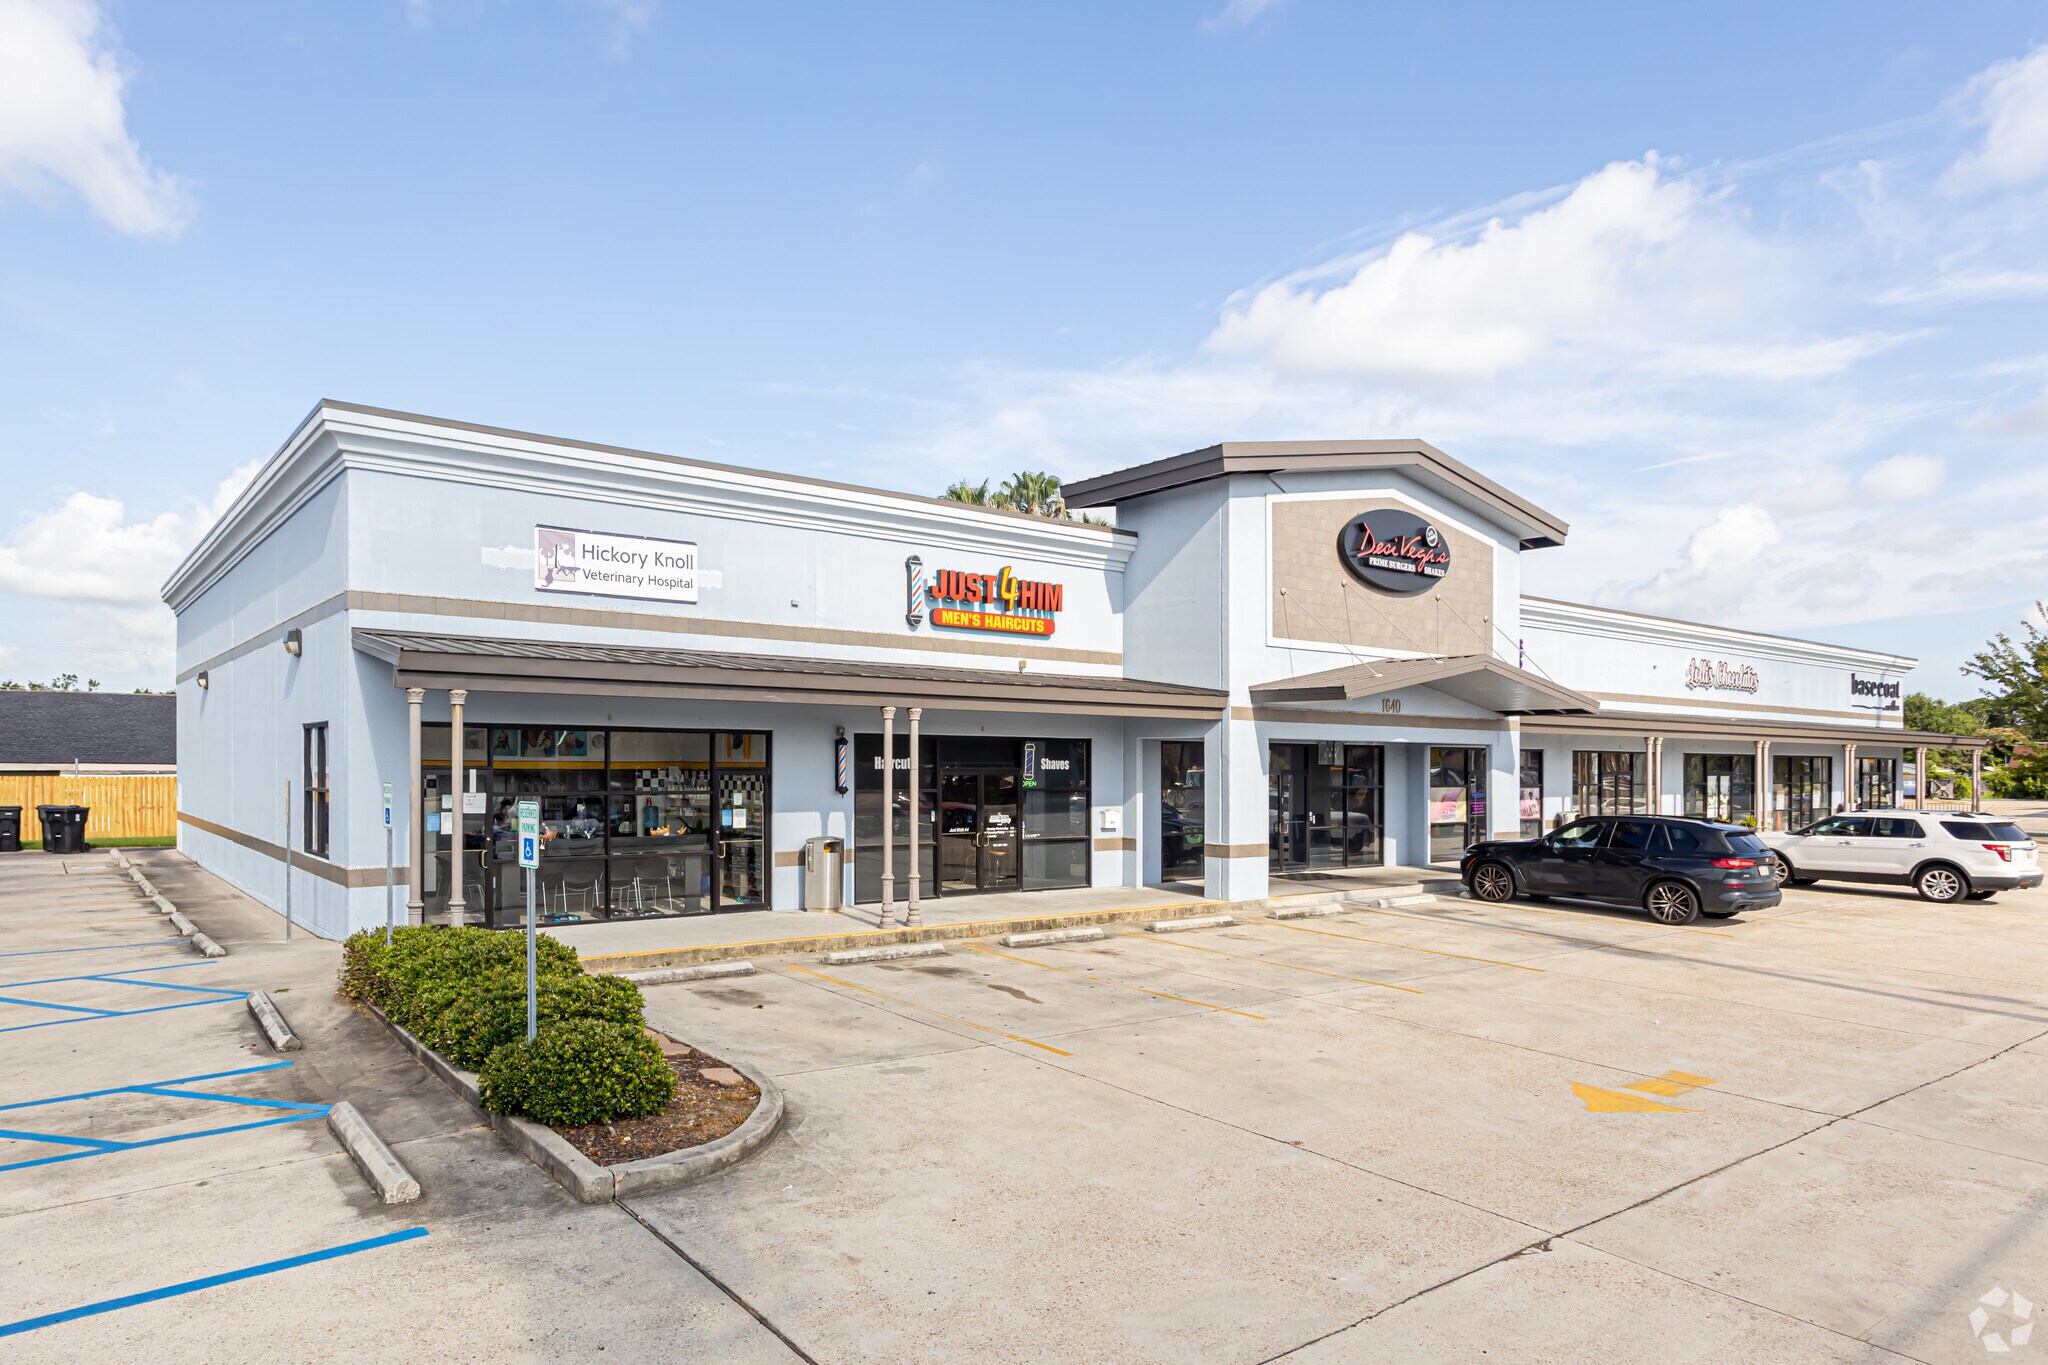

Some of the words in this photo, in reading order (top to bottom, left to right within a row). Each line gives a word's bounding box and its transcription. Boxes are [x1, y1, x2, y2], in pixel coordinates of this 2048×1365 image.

[582, 543, 648, 569] Hickory
[654, 551, 694, 570] Knoll
[1357, 521, 1399, 558] Desi
[1399, 534, 1451, 573] Vega's
[1368, 556, 1389, 568] PRIME
[1388, 561, 1416, 572] BURGERS
[1423, 566, 1445, 577] SHAKES
[582, 568, 644, 587] Veterinary
[648, 575, 694, 590] Hospital
[930, 568, 998, 604] JUST
[998, 565, 1020, 611] 4
[1020, 579, 1063, 612] HIM
[941, 610, 981, 627] MEN'S
[985, 615, 1045, 633] HAIRCUTS
[1851, 673, 1900, 698] basecoat
[1381, 698, 1401, 713] 1640
[1040, 758, 1070, 770] Shaves
